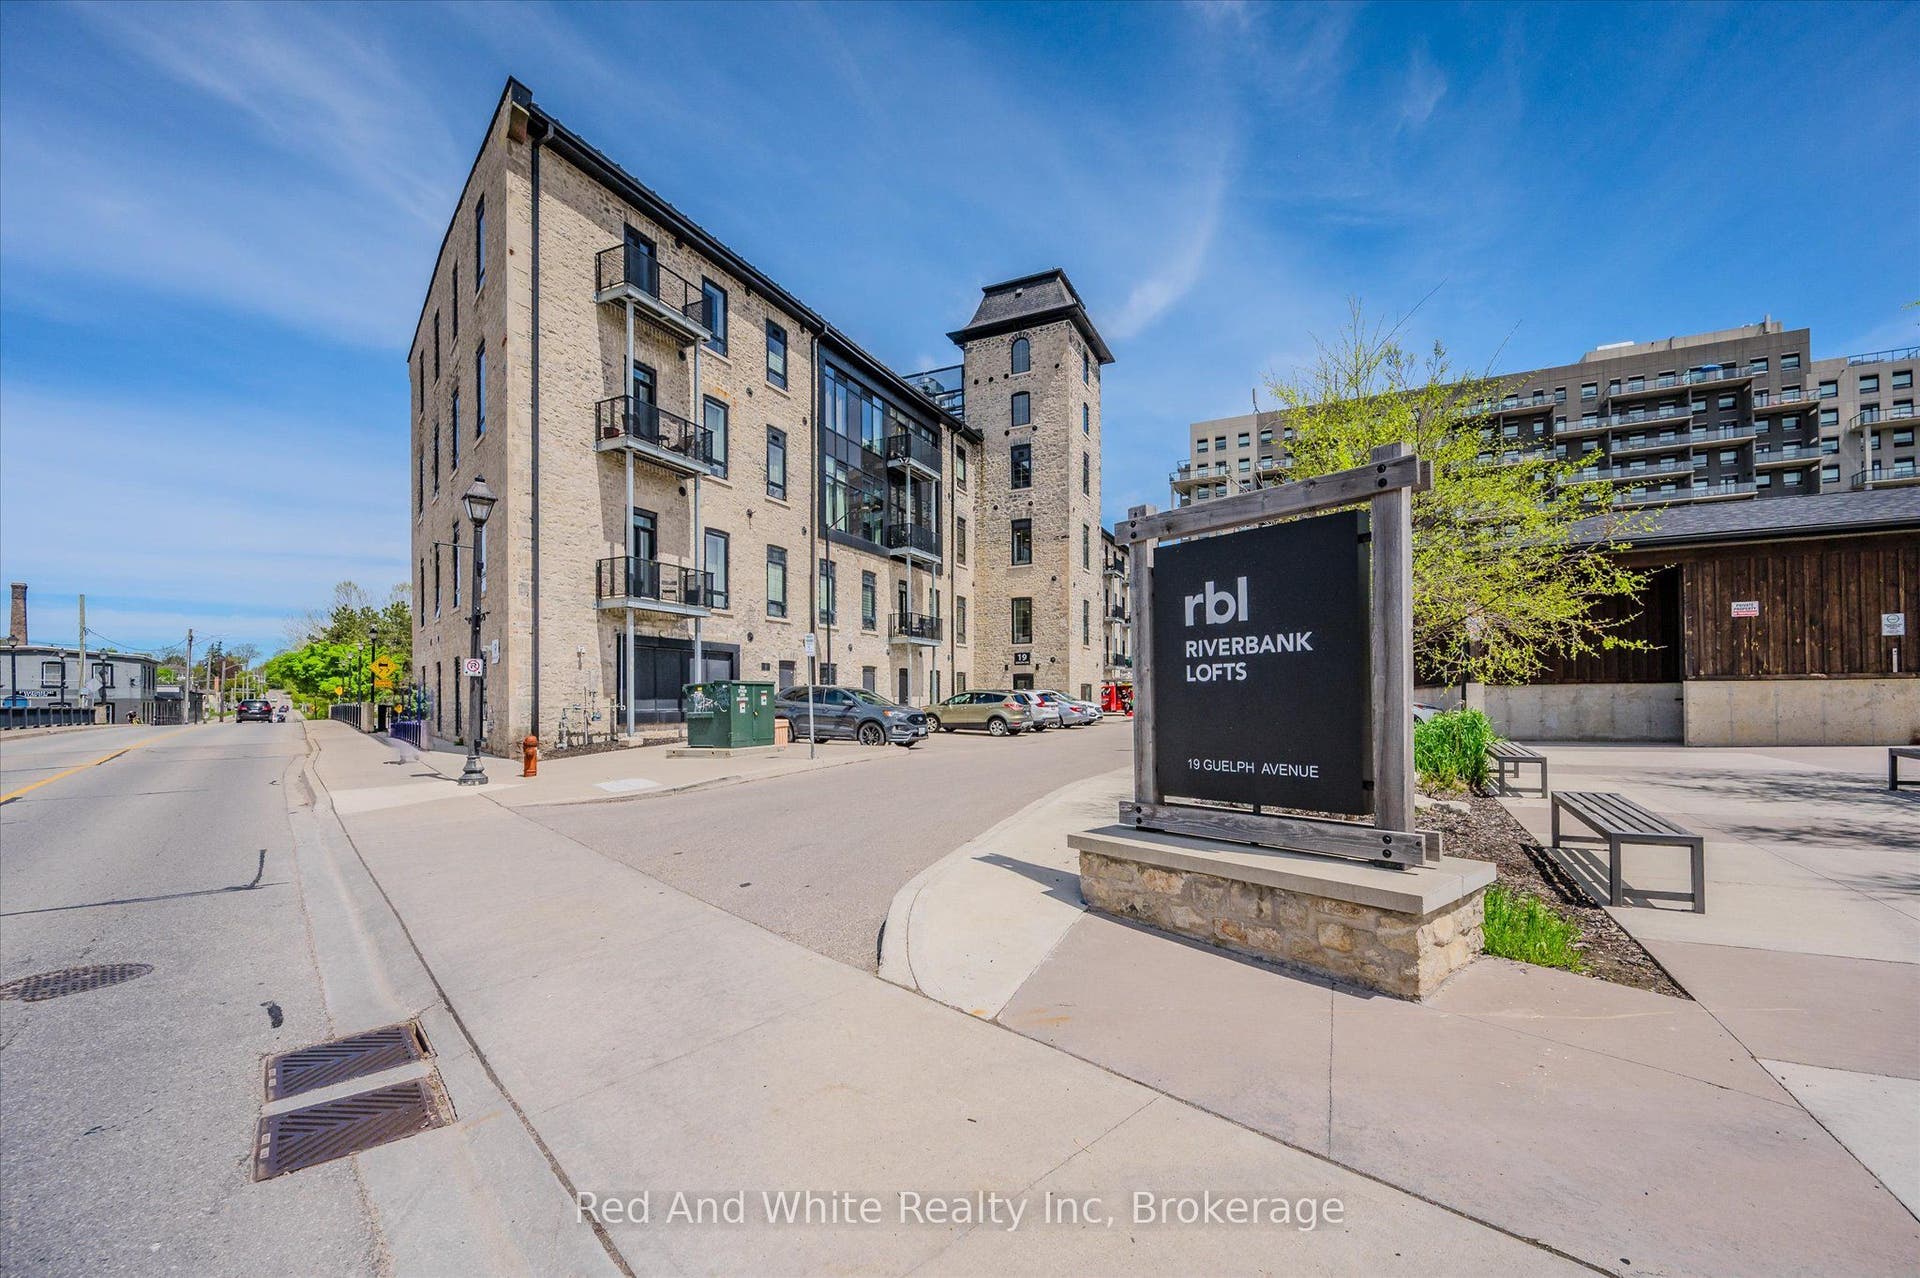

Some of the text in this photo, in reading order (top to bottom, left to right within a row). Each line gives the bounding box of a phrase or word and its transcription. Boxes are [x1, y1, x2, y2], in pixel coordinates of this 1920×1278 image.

[1184, 575, 1249, 627] rbl
[1185, 631, 1314, 658] RIVERBANK
[1017, 653, 1028, 661] 19
[1186, 661, 1248, 683] LOFTS
[1187, 758, 1320, 779] 19 GUELPH AVENUE
